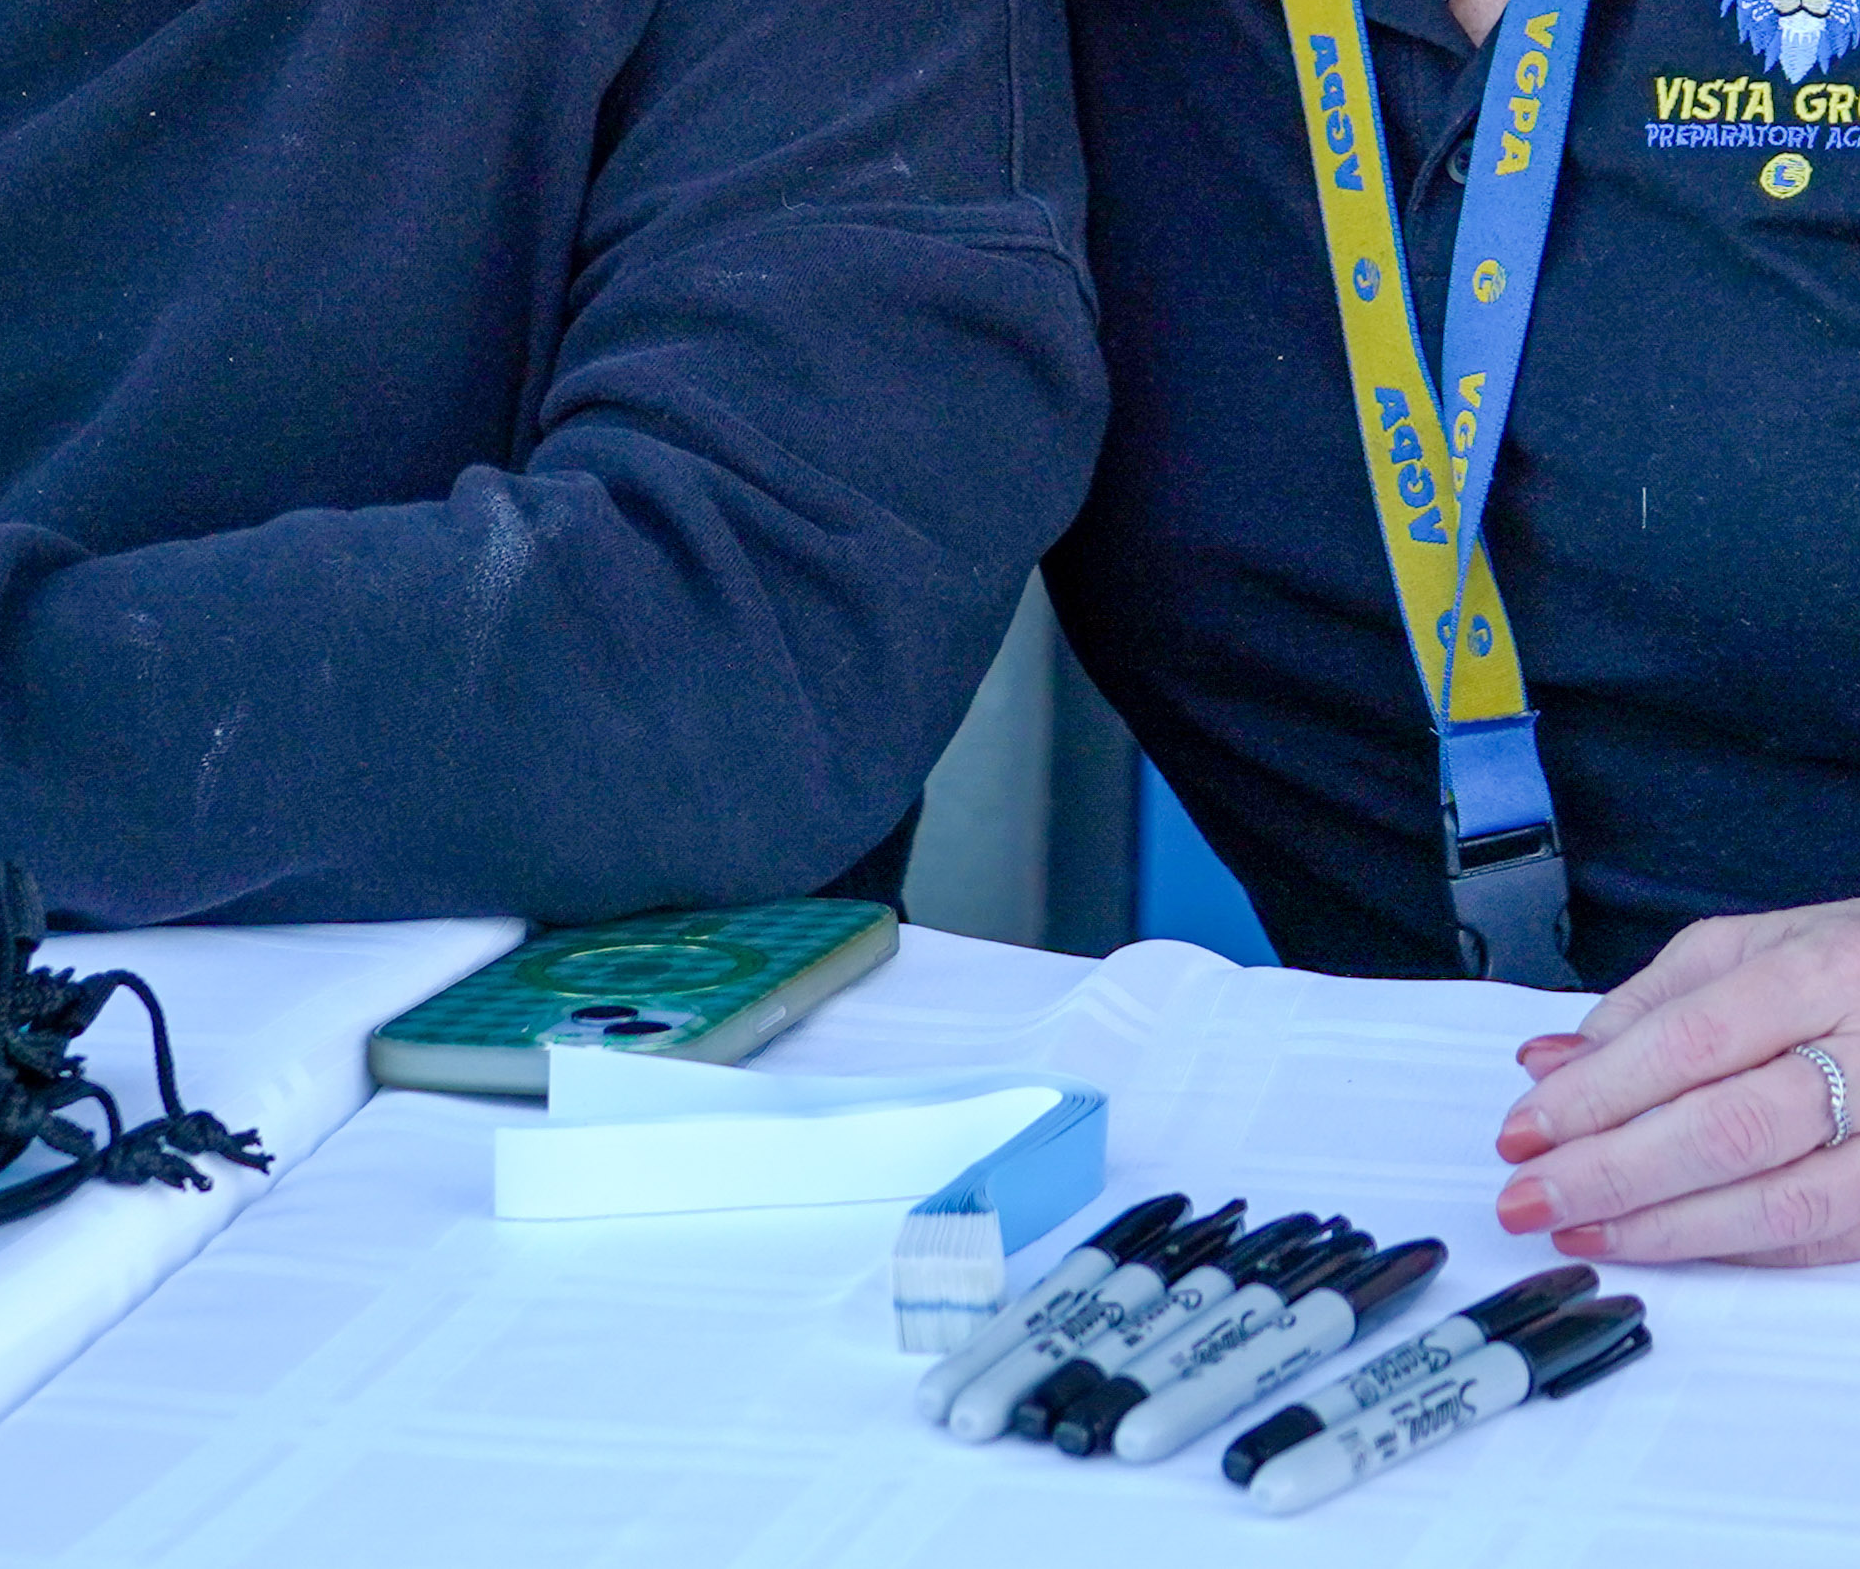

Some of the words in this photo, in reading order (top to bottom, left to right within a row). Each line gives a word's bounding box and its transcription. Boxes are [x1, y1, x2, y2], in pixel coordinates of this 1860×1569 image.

[1495, 11, 1559, 176] VGPA
[1645, 121, 1819, 150] PREPARATORY
[1653, 76, 1774, 123] VISTA
[1452, 371, 1487, 520] VGP
